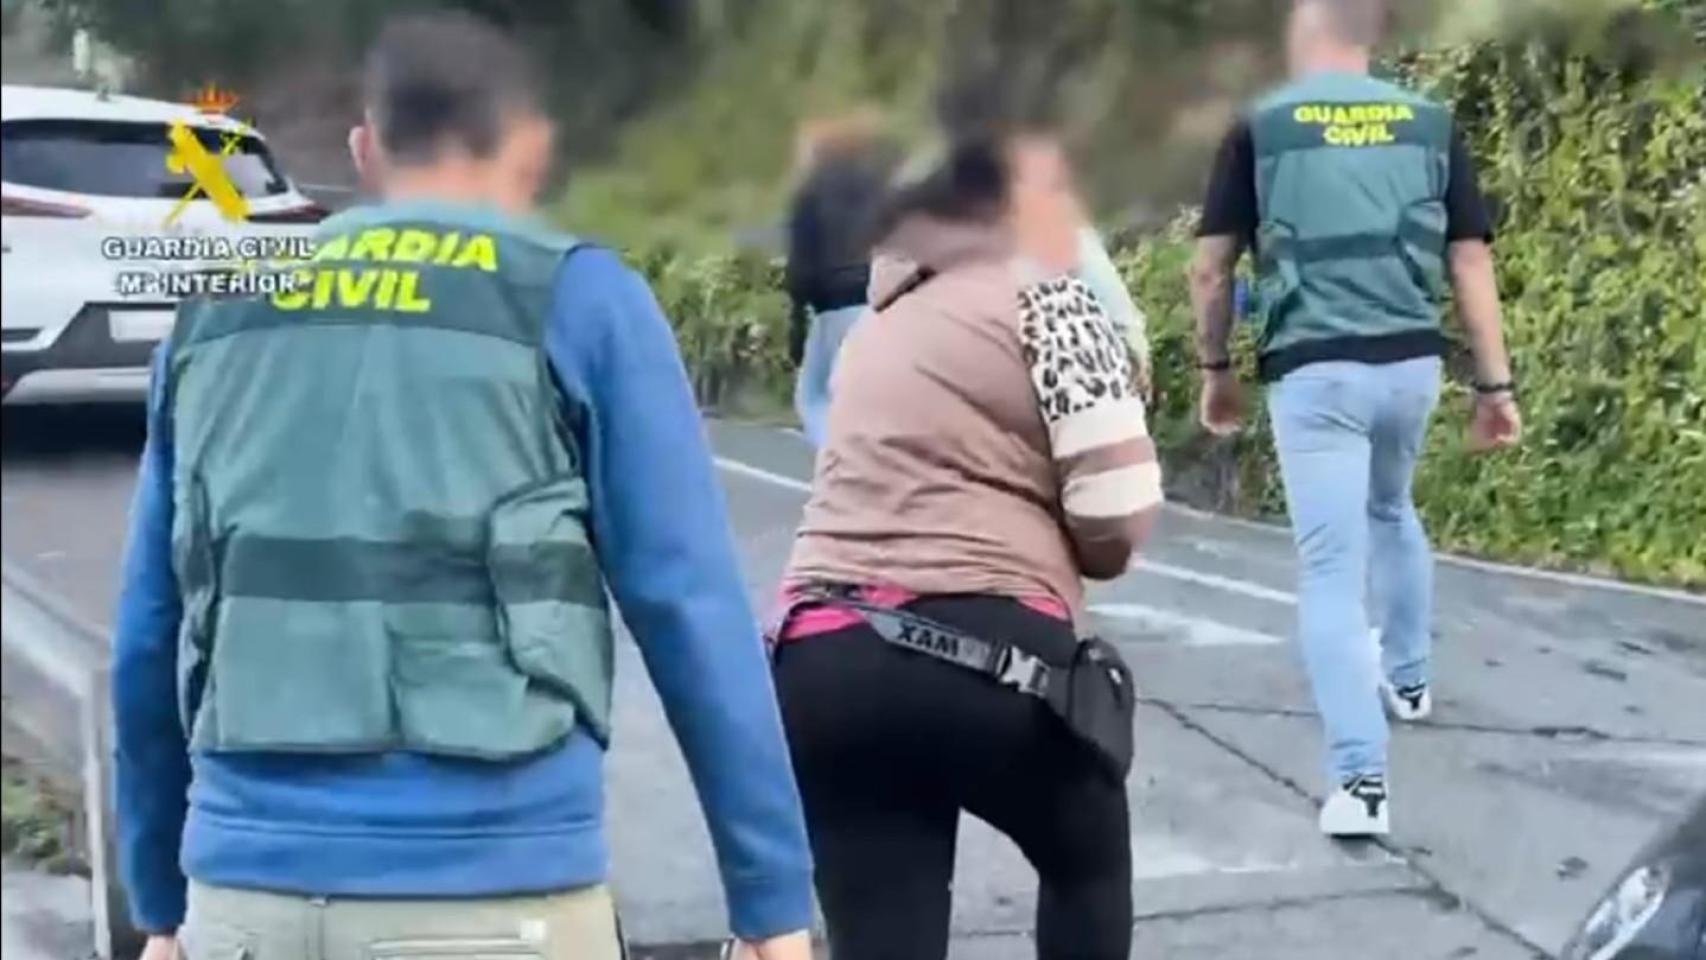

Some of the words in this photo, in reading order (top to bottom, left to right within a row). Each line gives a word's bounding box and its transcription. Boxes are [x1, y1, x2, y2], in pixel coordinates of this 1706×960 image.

[1293, 103, 1415, 124] GUARDIA
[1323, 123, 1396, 146] CIVIL
[241, 226, 498, 271] ARDIA
[272, 268, 432, 312] CIVIL
